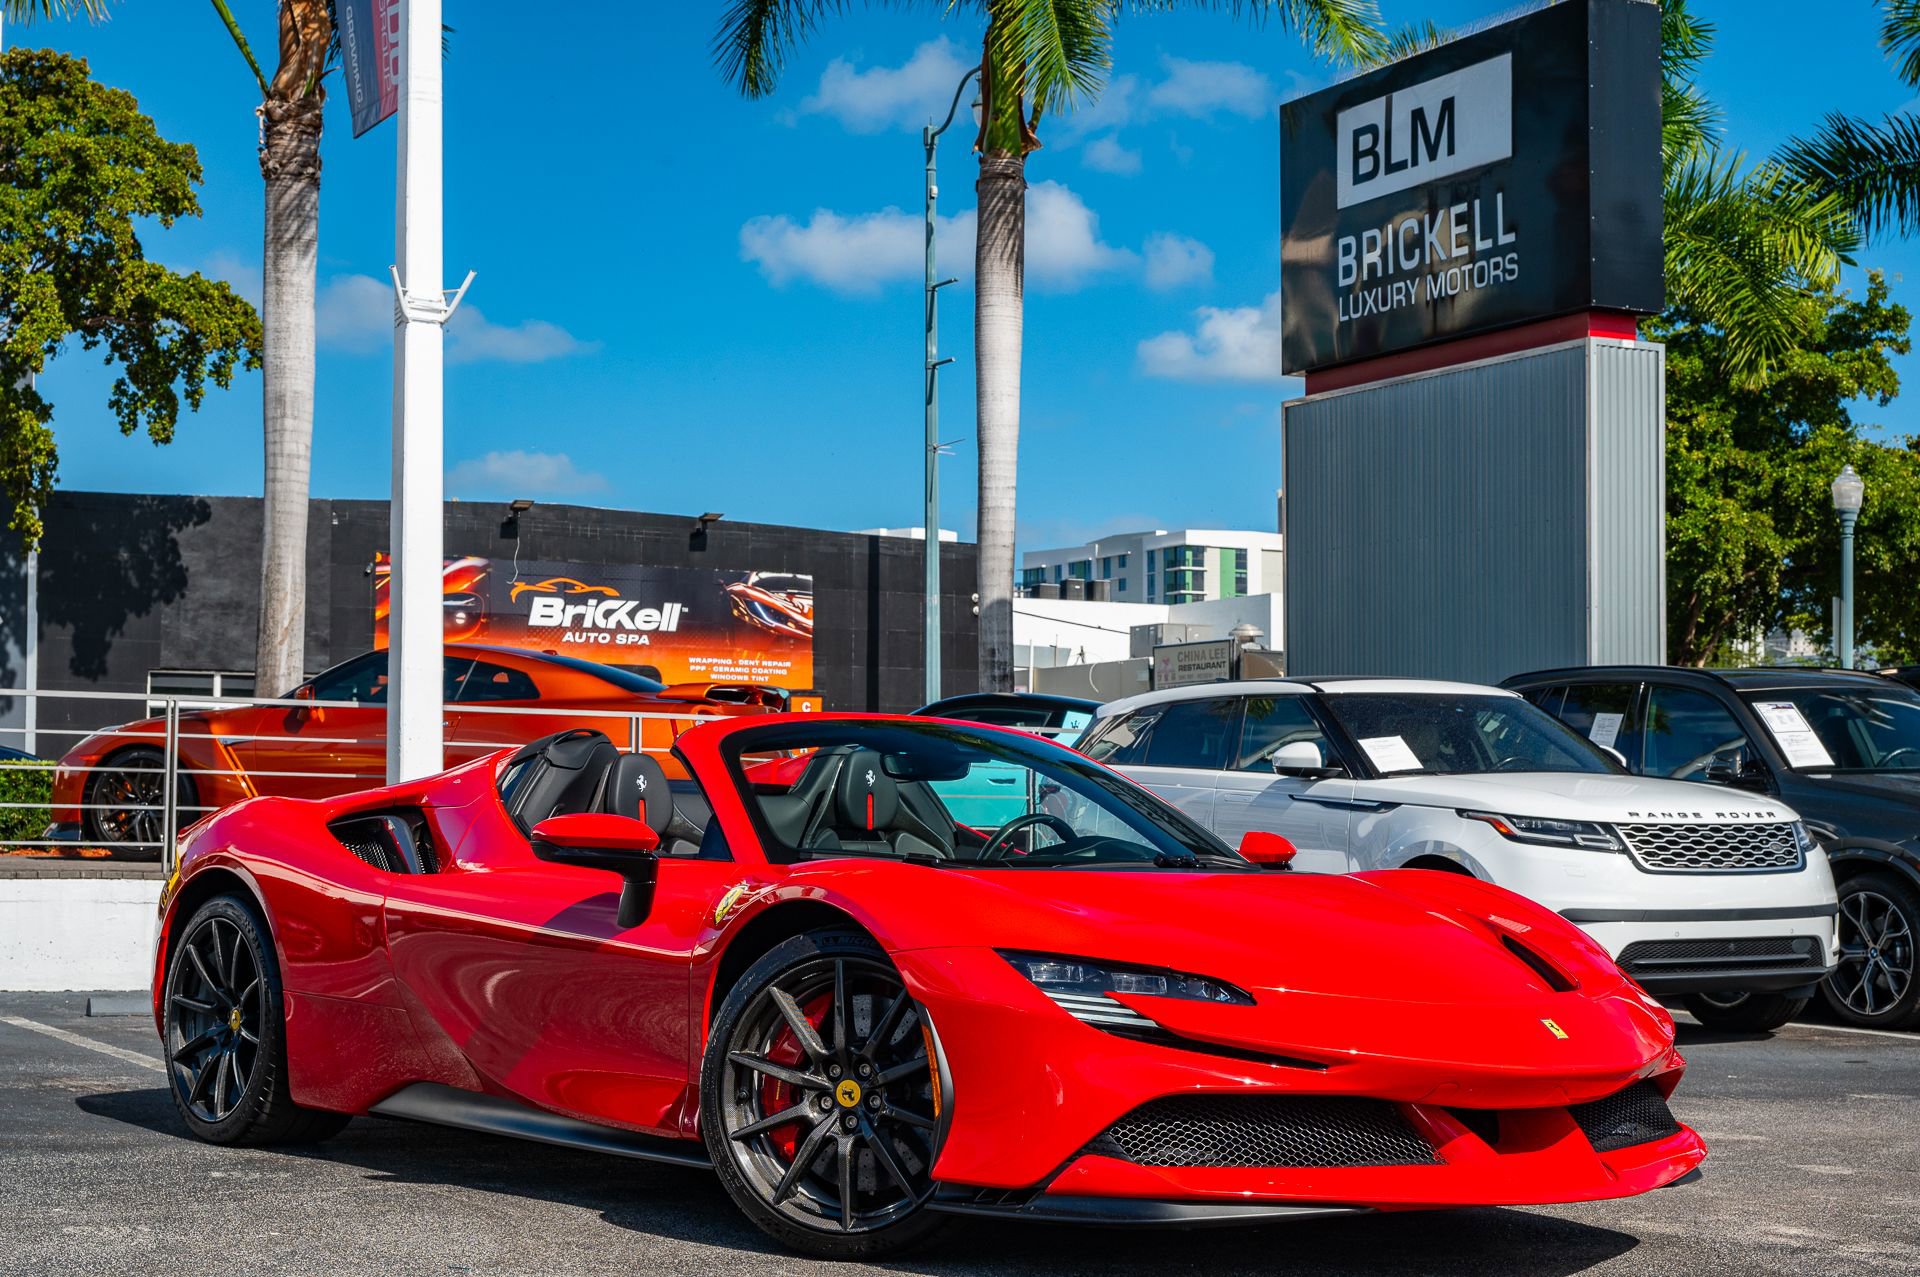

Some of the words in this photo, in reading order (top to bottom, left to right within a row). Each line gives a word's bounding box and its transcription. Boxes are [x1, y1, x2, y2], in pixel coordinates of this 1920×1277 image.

[1352, 94, 1456, 187] BLM
[1338, 192, 1517, 288] BRICKELL
[1339, 277, 1421, 322] LUXURY
[1426, 252, 1519, 300] MOTORS
[562, 632, 611, 644] AUTO
[615, 633, 650, 645] SPA
[1177, 649, 1206, 662] CHINA
[1208, 648, 1226, 660] LEE
[688, 657, 732, 665] WRAPPING
[738, 659, 760, 667] DENT
[761, 660, 791, 668] REPAIR
[1178, 660, 1227, 672] RESTAURANT
[713, 666, 750, 674] CERAMIC
[751, 668, 788, 676] COATING
[710, 673, 749, 682] WINDOWS
[750, 675, 770, 683] TINT
[1627, 811, 1703, 819] RANGE
[1715, 811, 1777, 819] ROVER
